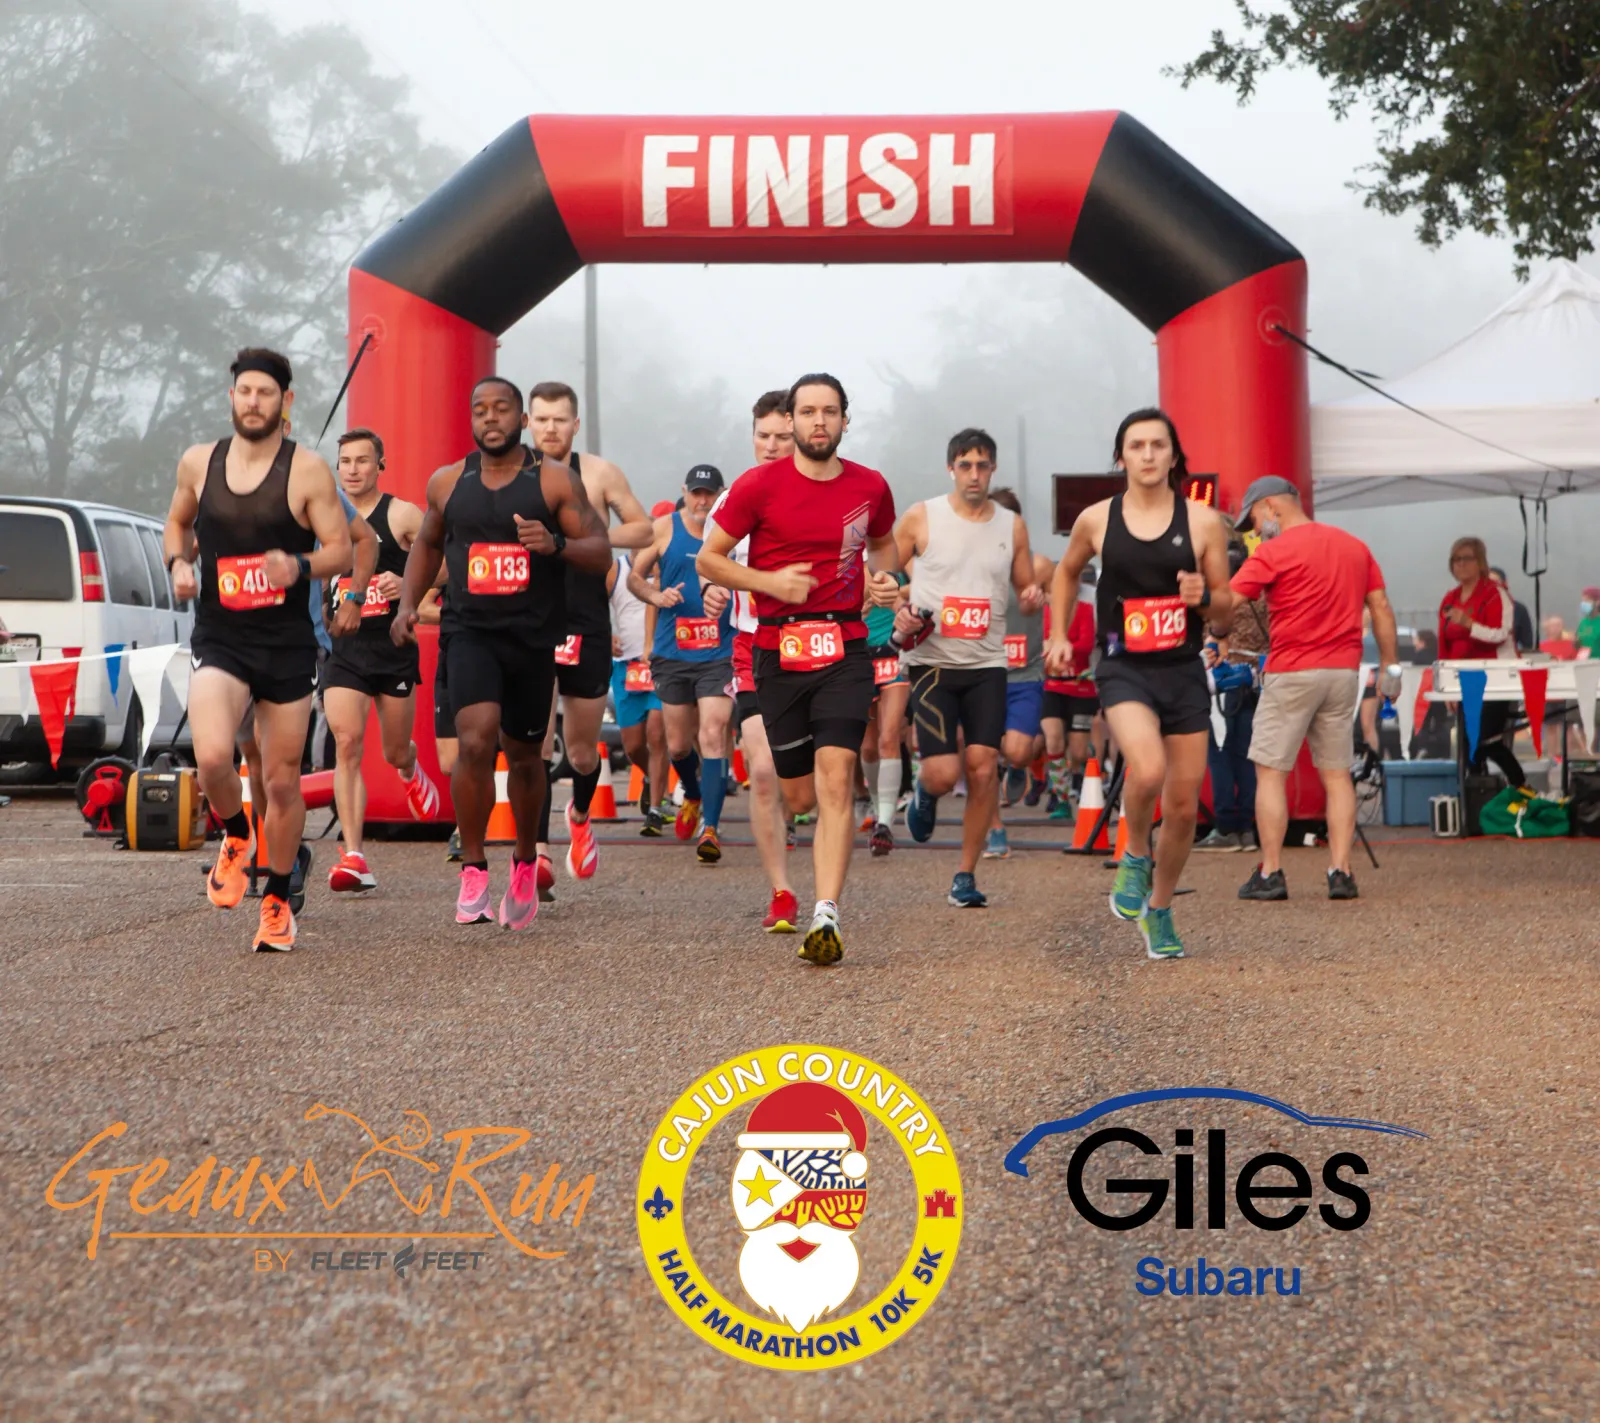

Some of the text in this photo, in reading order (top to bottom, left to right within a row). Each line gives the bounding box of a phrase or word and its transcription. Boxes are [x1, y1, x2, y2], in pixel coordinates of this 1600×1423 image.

[641, 132, 996, 228] FINISH
[243, 567, 279, 595] 40
[494, 555, 528, 581] 133
[960, 607, 990, 628] 434
[1151, 607, 1186, 637] 126
[693, 625, 718, 640] 139
[810, 632, 836, 657] 96
